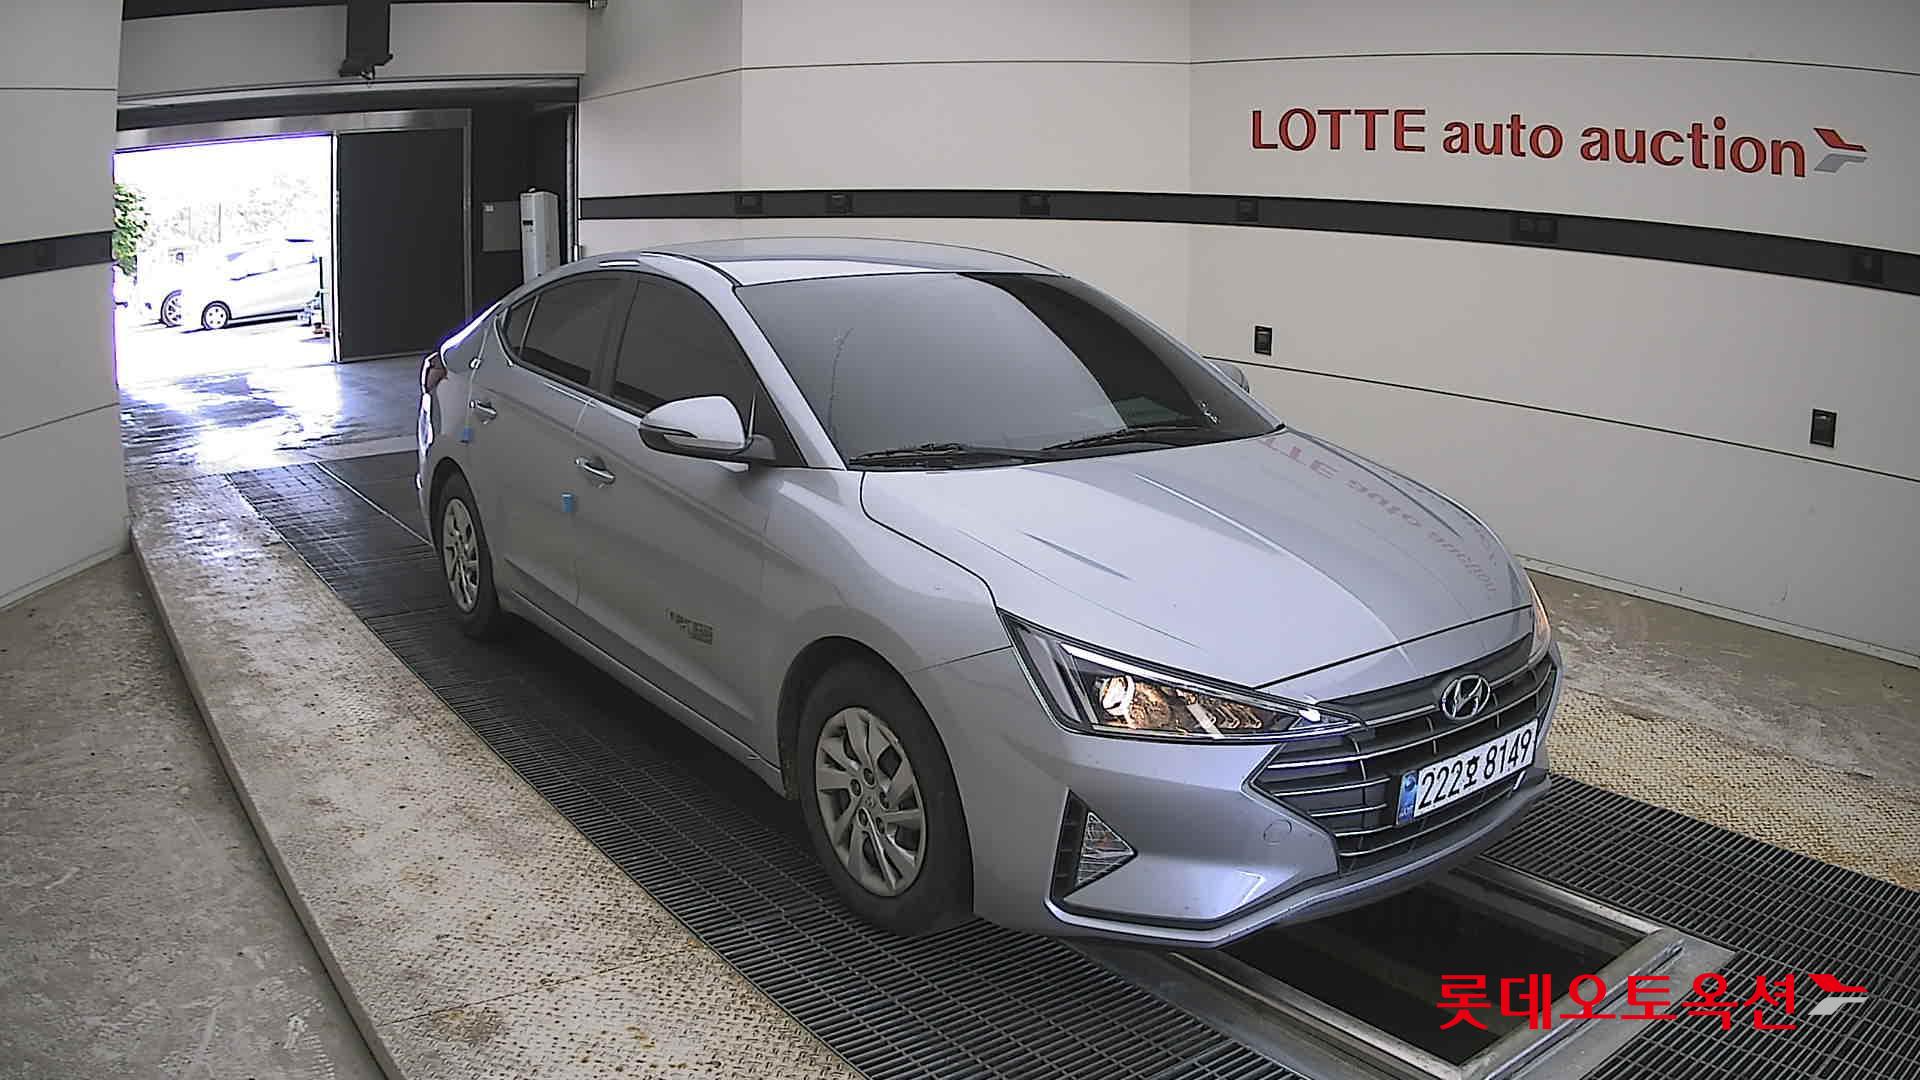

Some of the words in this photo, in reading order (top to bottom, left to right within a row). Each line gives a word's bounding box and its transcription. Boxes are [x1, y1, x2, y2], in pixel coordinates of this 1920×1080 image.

[1251, 109, 1426, 152] LOTTE
[1442, 114, 1563, 158] auto
[1579, 116, 1806, 177] auction
[1483, 728, 1532, 780] 8149
